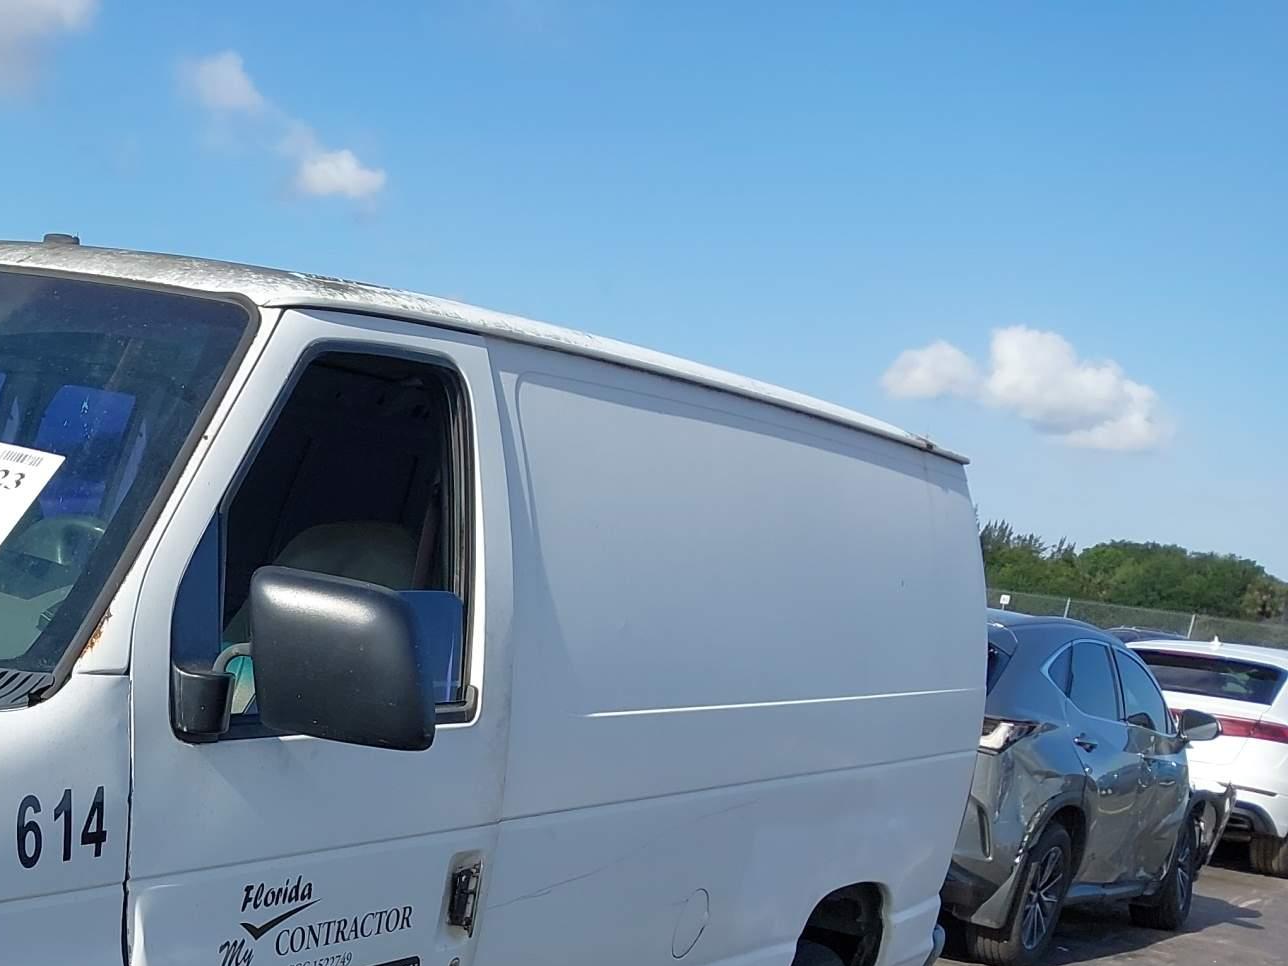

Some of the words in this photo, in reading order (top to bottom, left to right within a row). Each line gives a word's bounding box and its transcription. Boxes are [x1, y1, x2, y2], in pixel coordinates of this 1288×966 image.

[16, 785, 107, 869] 614
[240, 874, 313, 912] Florida
[274, 905, 413, 957] CONTRACTOR
